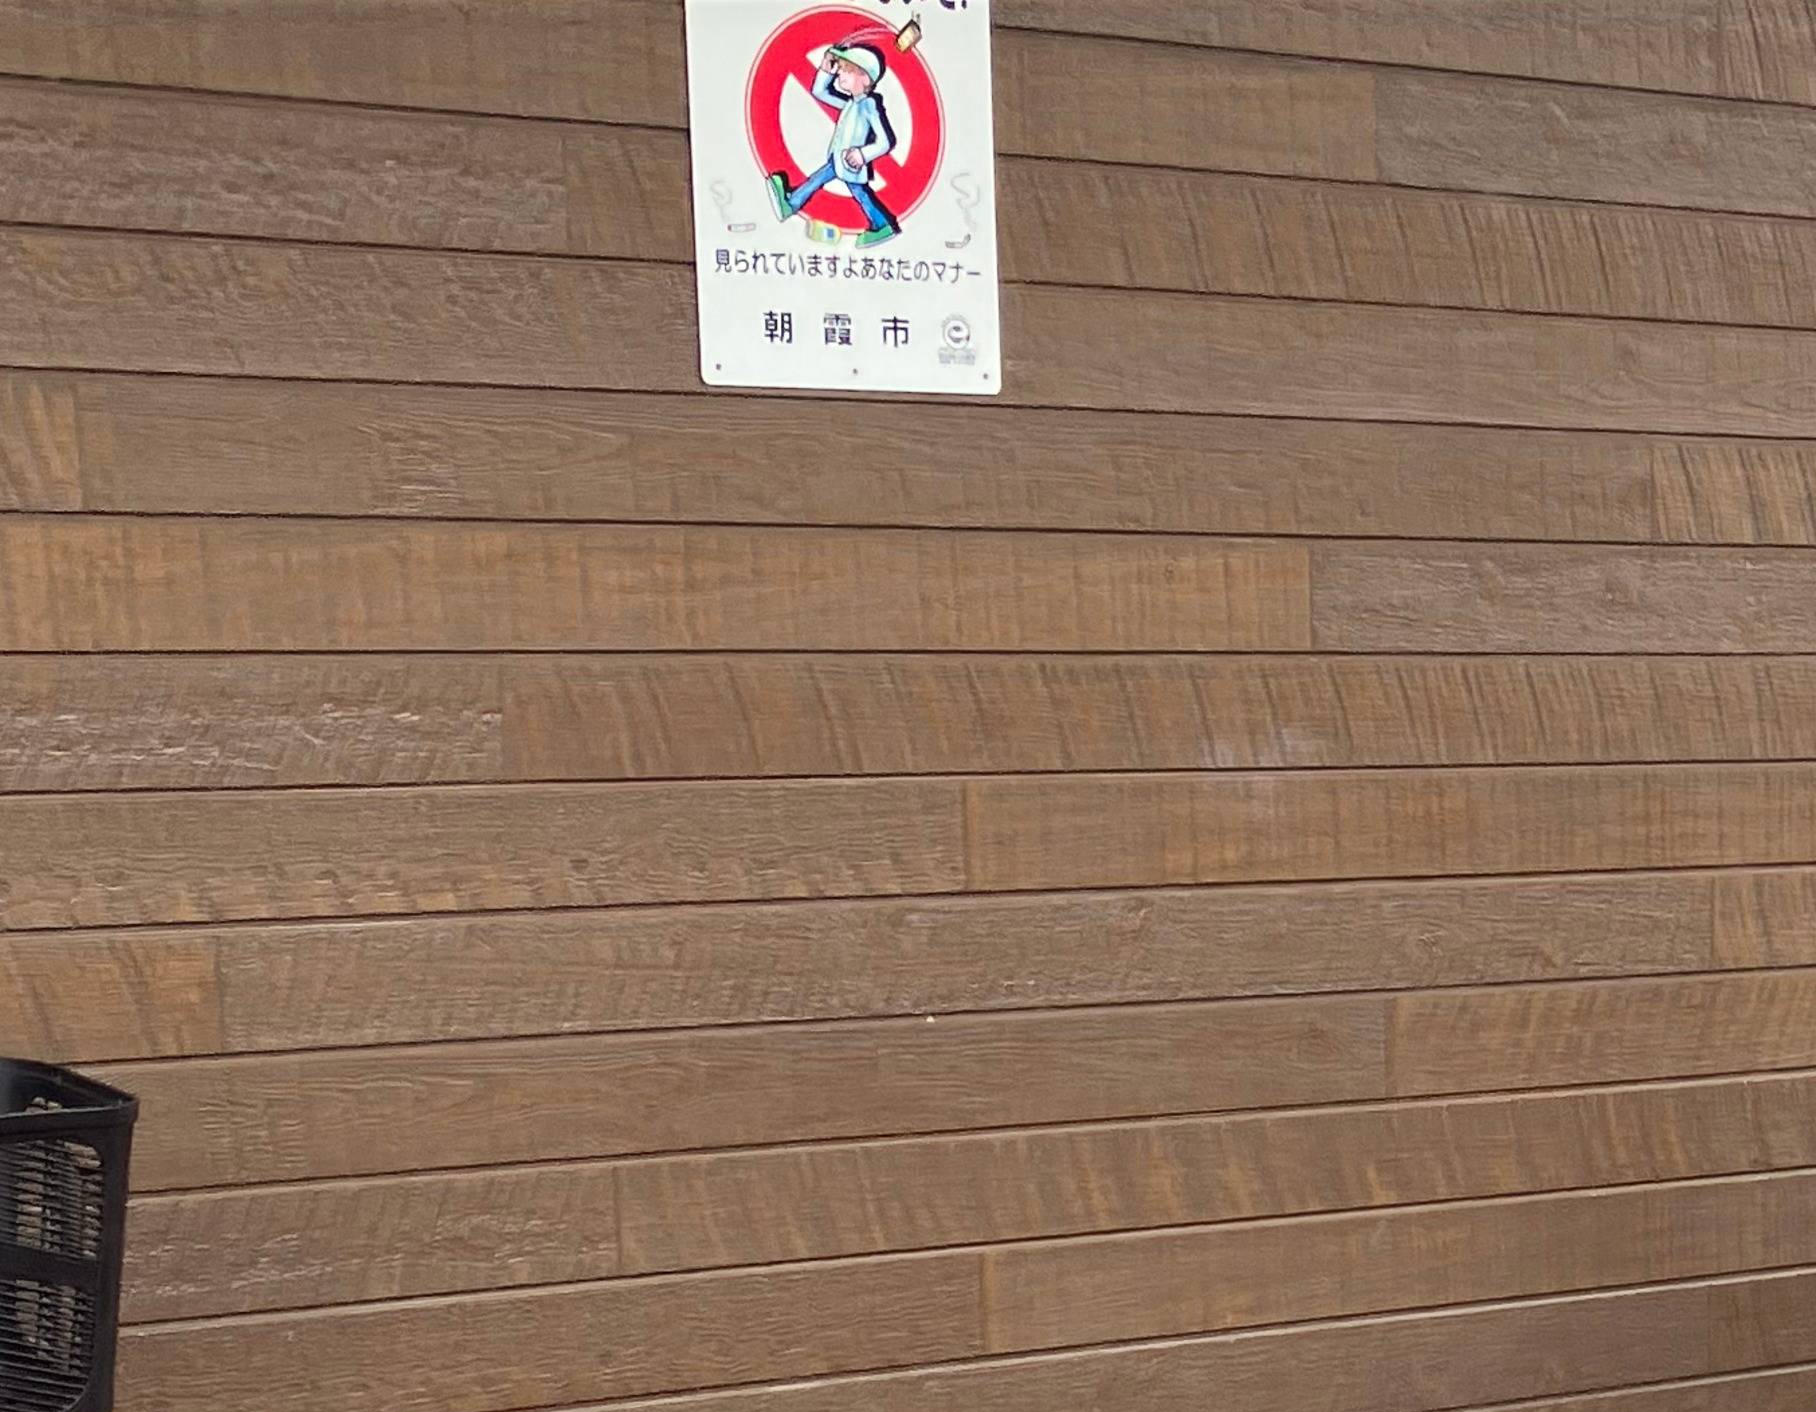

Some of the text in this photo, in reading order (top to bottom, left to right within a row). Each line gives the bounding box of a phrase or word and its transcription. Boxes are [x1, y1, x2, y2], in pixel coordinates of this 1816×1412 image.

[715, 248, 982, 284] 見られていますよあなたのマナー
[762, 310, 910, 348] 朝霞市
